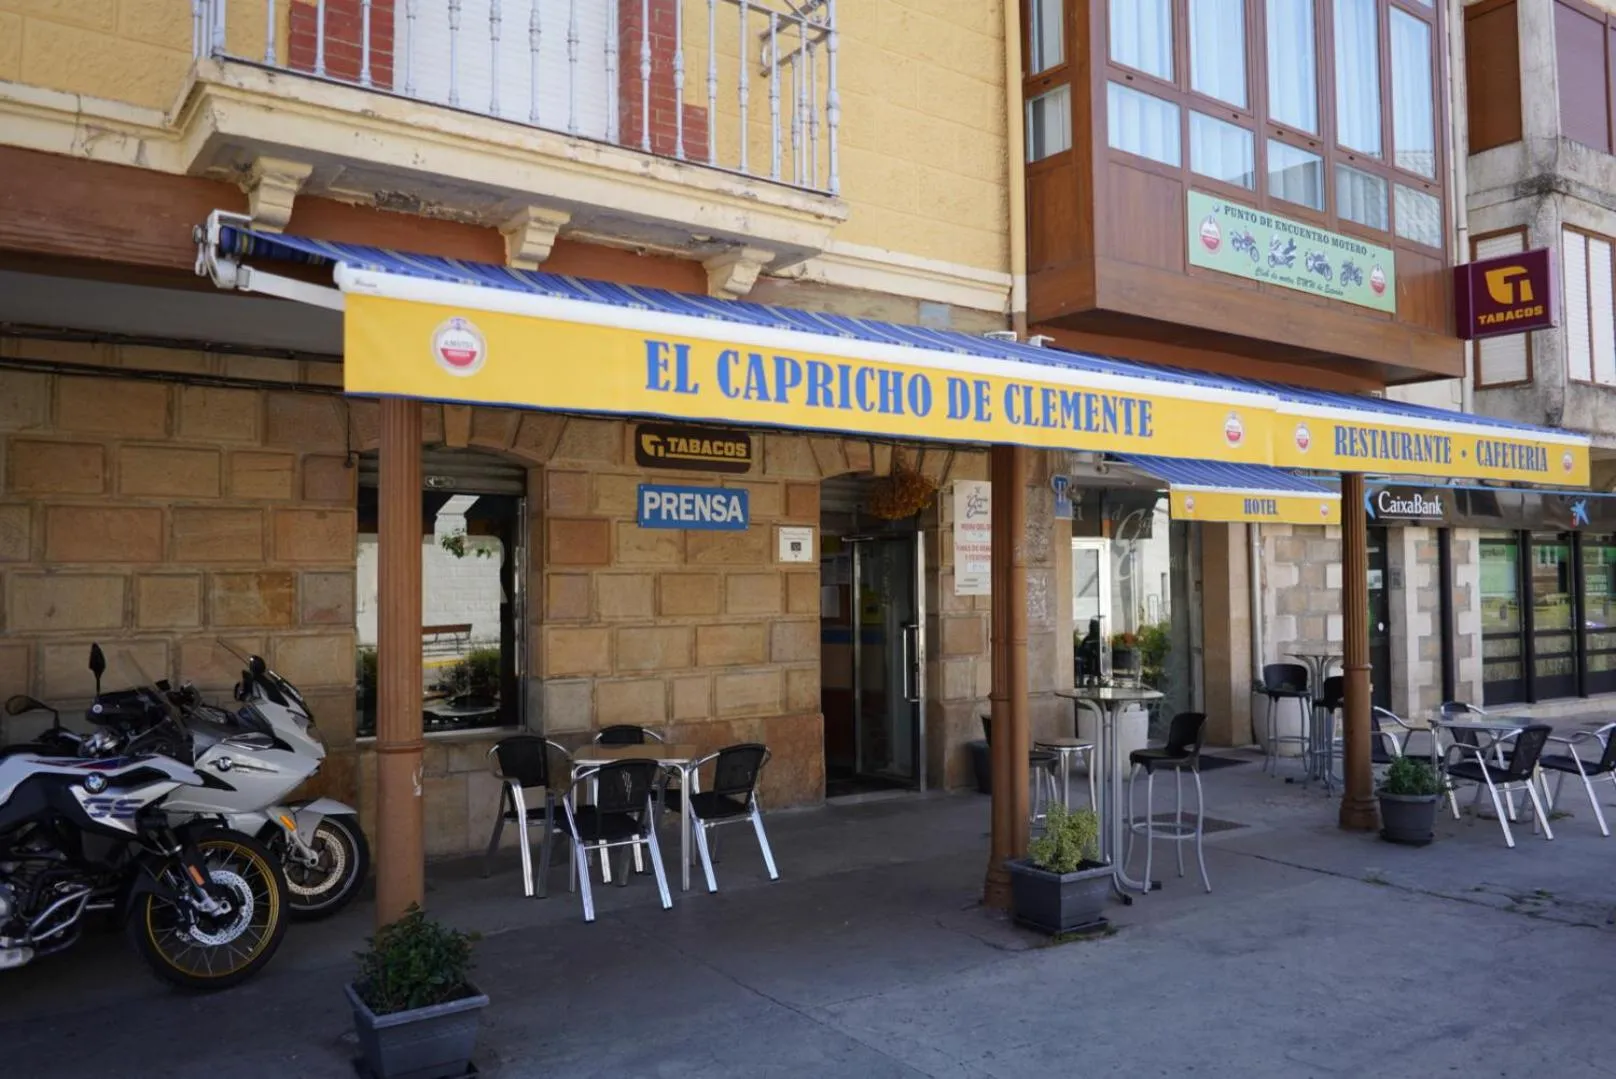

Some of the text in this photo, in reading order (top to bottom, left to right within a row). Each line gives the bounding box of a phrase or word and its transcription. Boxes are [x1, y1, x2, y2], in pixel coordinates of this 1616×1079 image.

[1224, 205, 1368, 256] PUNTO DE ENCUENTRO MOTERO
[1478, 305, 1543, 325] TABACOS
[644, 339, 1153, 438] EL CAPRICHO DE CLEMENTE
[667, 437, 747, 457] TABACOS
[1334, 425, 1549, 472] RESTAURANTE CAFETERÍA
[643, 491, 744, 523] PRENSA
[1244, 498, 1278, 516] HOTEL
[1378, 491, 1443, 515] CaixaBank
[83, 797, 146, 819] GS
